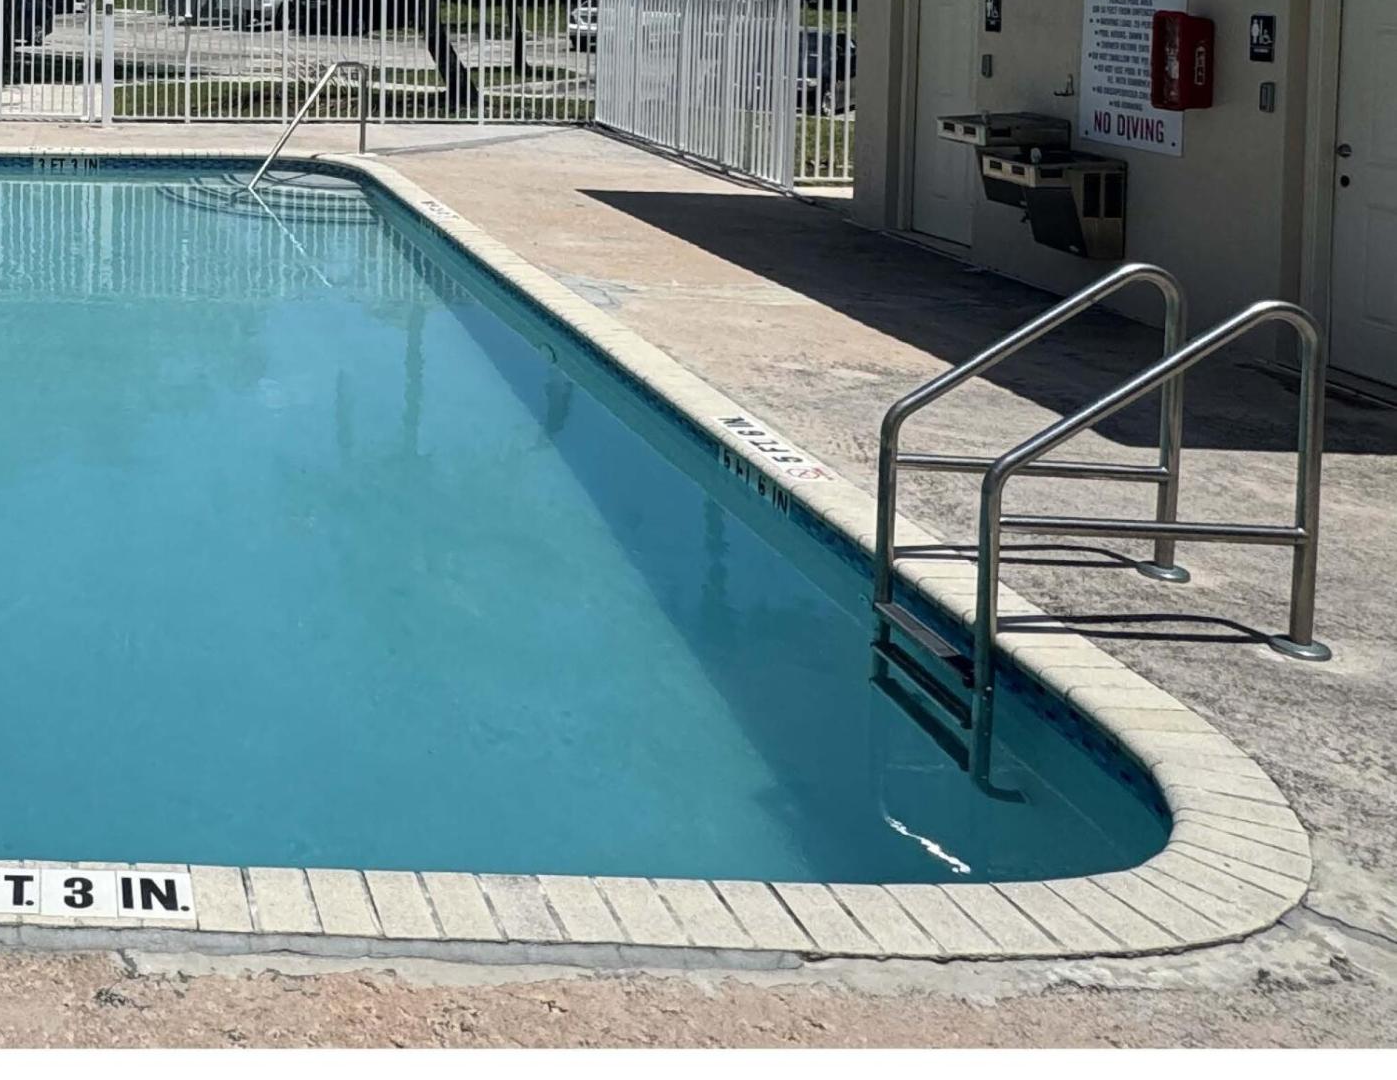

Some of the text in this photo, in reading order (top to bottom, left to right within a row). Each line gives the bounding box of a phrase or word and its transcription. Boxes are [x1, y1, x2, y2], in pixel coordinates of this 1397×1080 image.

[1094, 110, 1165, 144] NO DIVING
[63, 877, 94, 909] 3
[121, 877, 191, 912] IN.
